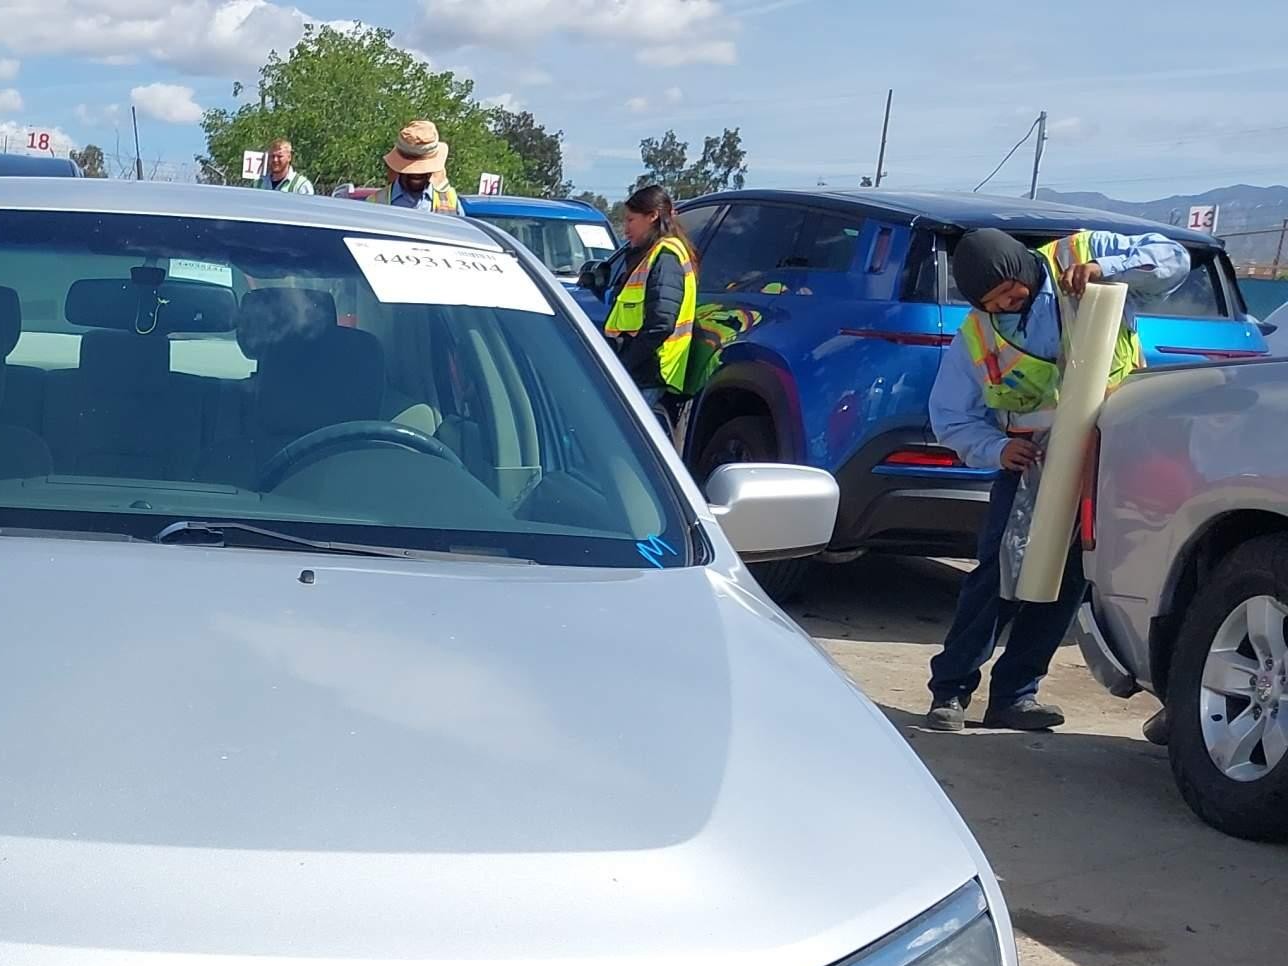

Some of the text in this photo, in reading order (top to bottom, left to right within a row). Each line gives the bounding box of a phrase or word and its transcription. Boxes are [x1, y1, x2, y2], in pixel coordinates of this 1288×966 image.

[26, 132, 50, 150] 18
[245, 157, 264, 174] 17
[1190, 210, 1215, 228] 13
[373, 253, 504, 274] 44931304
